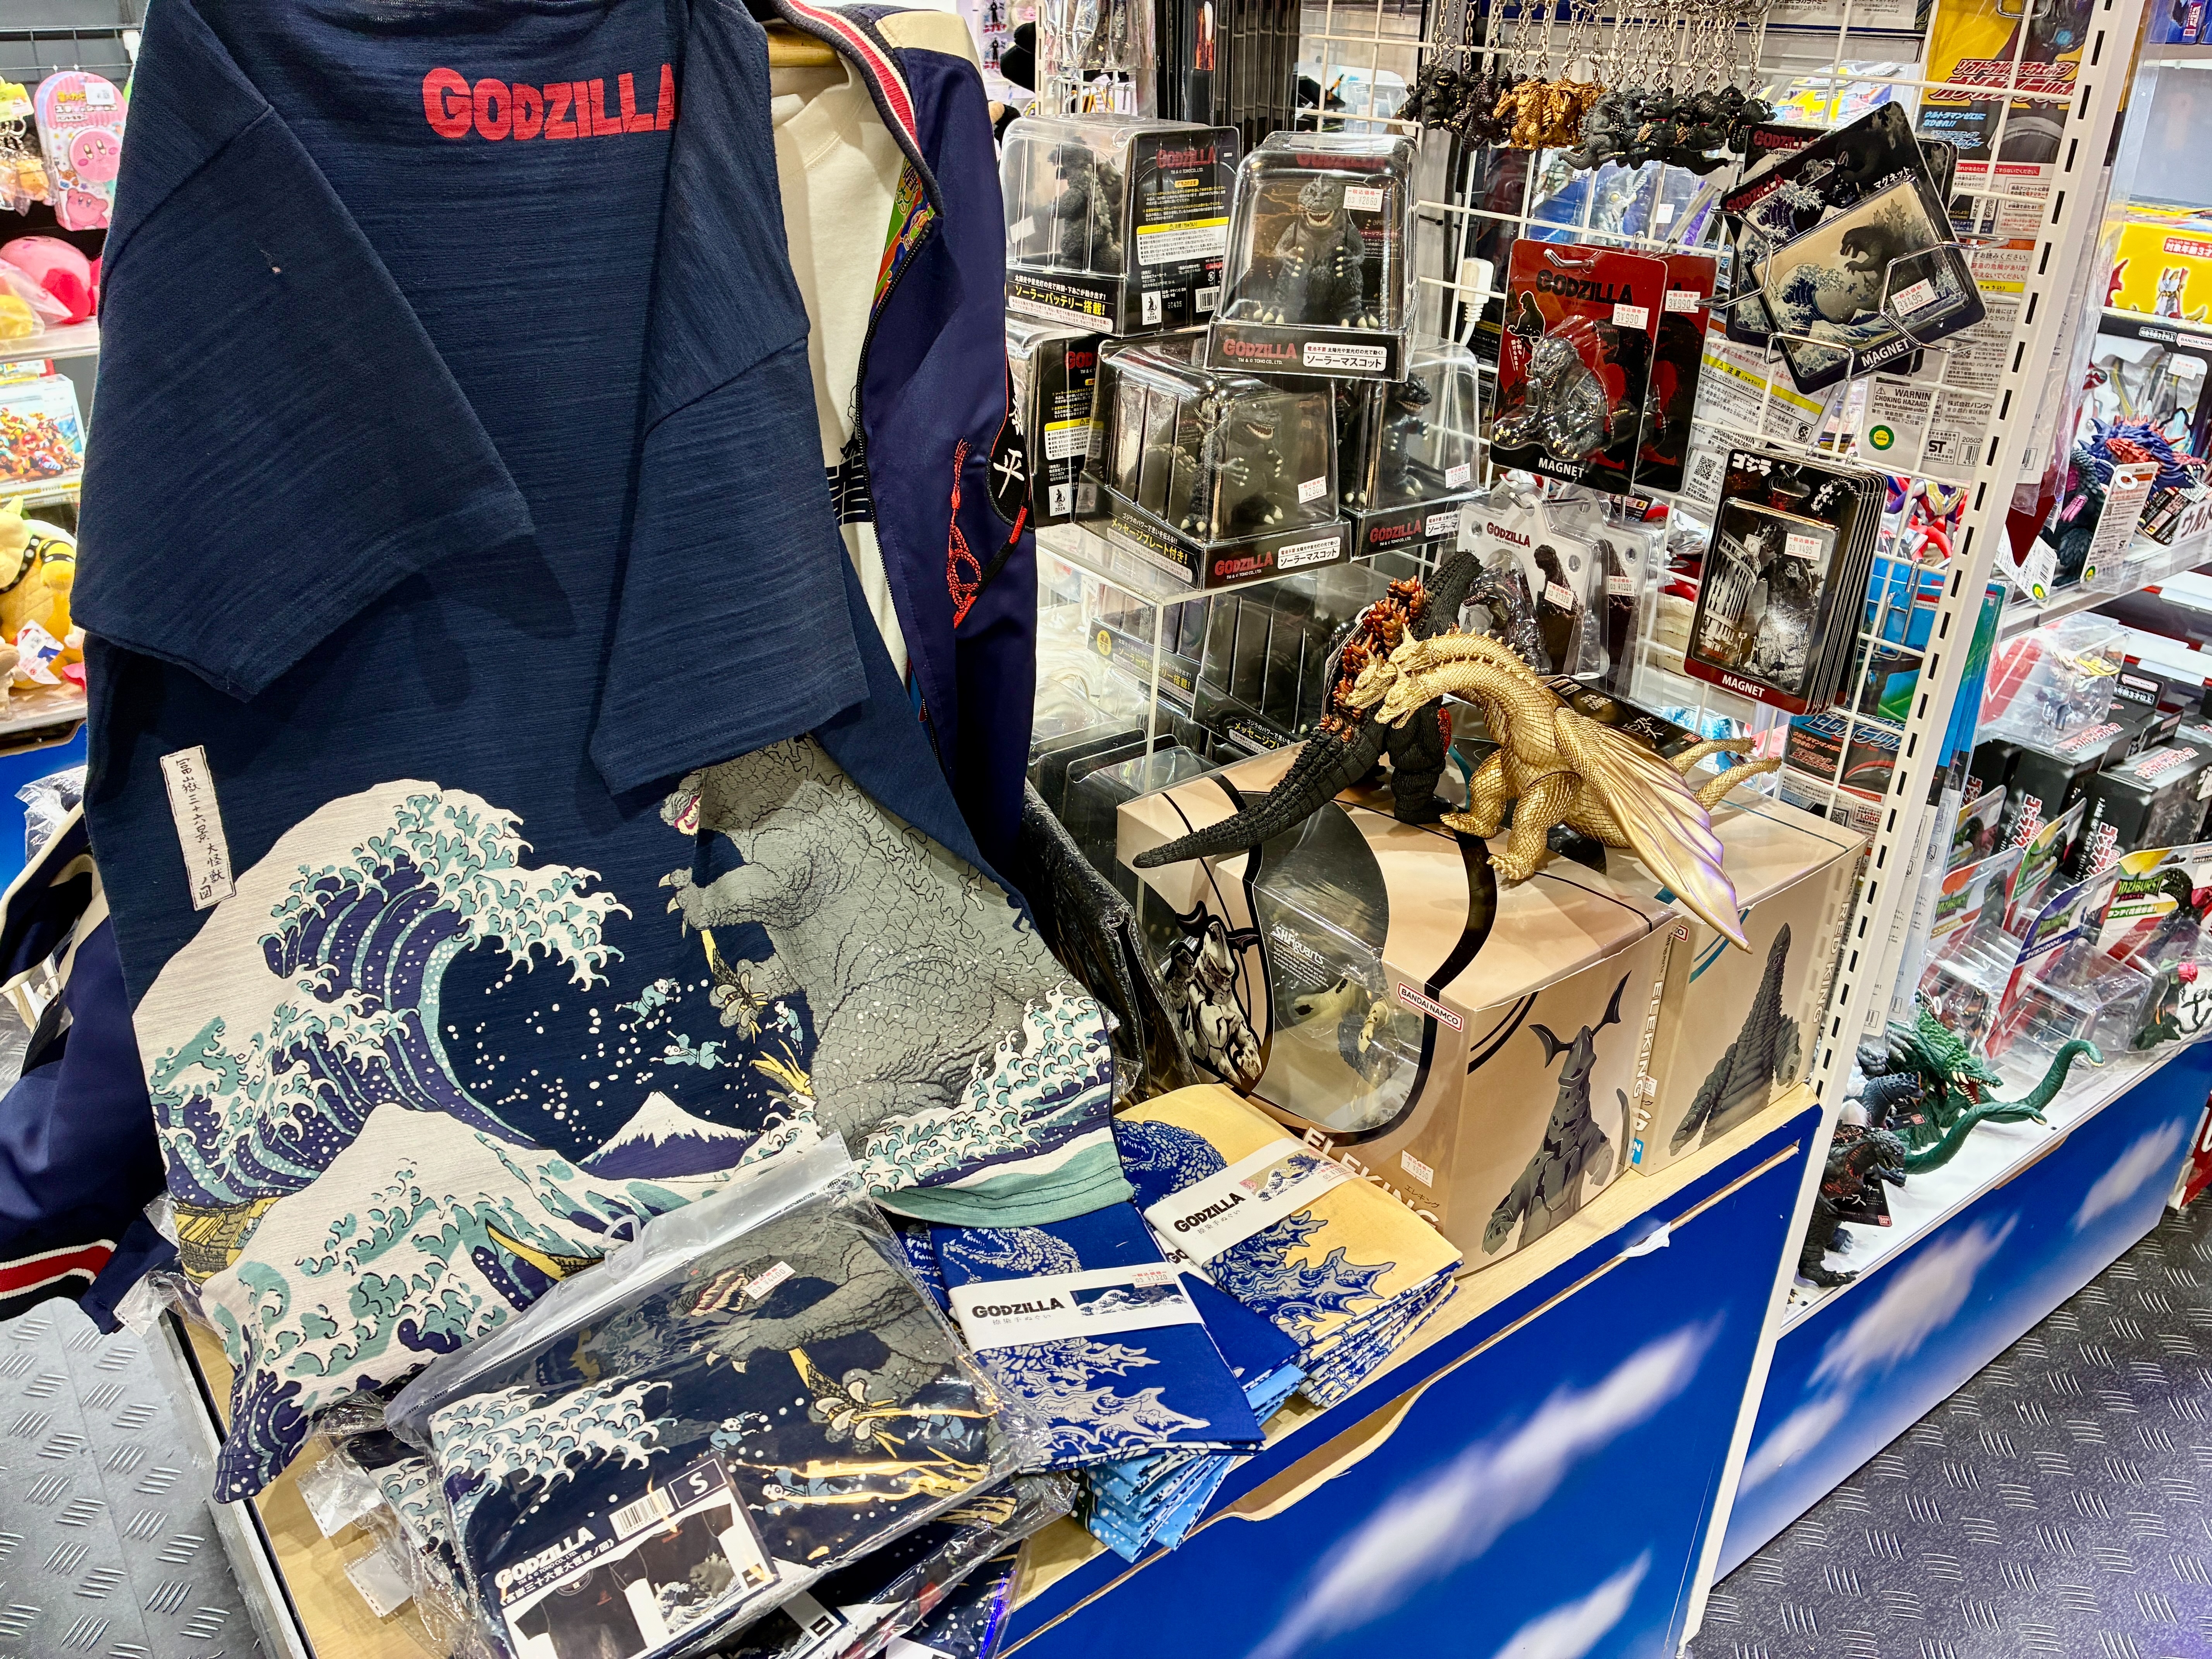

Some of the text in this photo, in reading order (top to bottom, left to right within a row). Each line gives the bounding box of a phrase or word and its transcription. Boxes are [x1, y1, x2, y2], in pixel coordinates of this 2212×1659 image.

[1156, 145, 1215, 169] GODZILLA
[1874, 167, 1910, 188] マグネット
[1359, 196, 1377, 206] ¥2860
[1726, 174, 1785, 212] GODZILLA
[1536, 269, 1633, 305] GODZILLA
[1015, 285, 1106, 316] ソーラーバッテリー搭載!
[1223, 338, 1297, 359] GODZILLA
[1861, 338, 1911, 368] MAGNET
[1307, 355, 1381, 368] ソーラーマスコット
[1875, 395, 1902, 404] CHOKING
[1895, 388, 1932, 401] WARNIN
[1714, 429, 1733, 441] CHOKING
[1929, 440, 1947, 453] ST
[993, 448, 1025, 498] 平
[1538, 457, 1585, 478] MAGNET
[1732, 453, 1772, 477] ゴジラ
[1305, 484, 1323, 497] ¥2860
[1111, 518, 1188, 565] メッセージプレート付き!
[1370, 519, 1422, 543] GODZILLA
[1487, 522, 1530, 548] GODZILLA
[1215, 551, 1273, 575] GODZILLA
[1281, 548, 1336, 566] ソーラーマスコット
[1722, 674, 1765, 698] MAGNET
[1401, 988, 1459, 1026] BANDAI NAMCO
[1633, 981, 1663, 1099] ELEKING
[1404, 1185, 1440, 1208] エレキング
[1173, 1192, 1246, 1233] GODZILLA
[763, 1268, 786, 1285] ¥4400
[972, 1297, 1066, 1319] GODZILLA
[689, 1472, 708, 1495] S
[494, 1526, 596, 1589] GODZILLA
